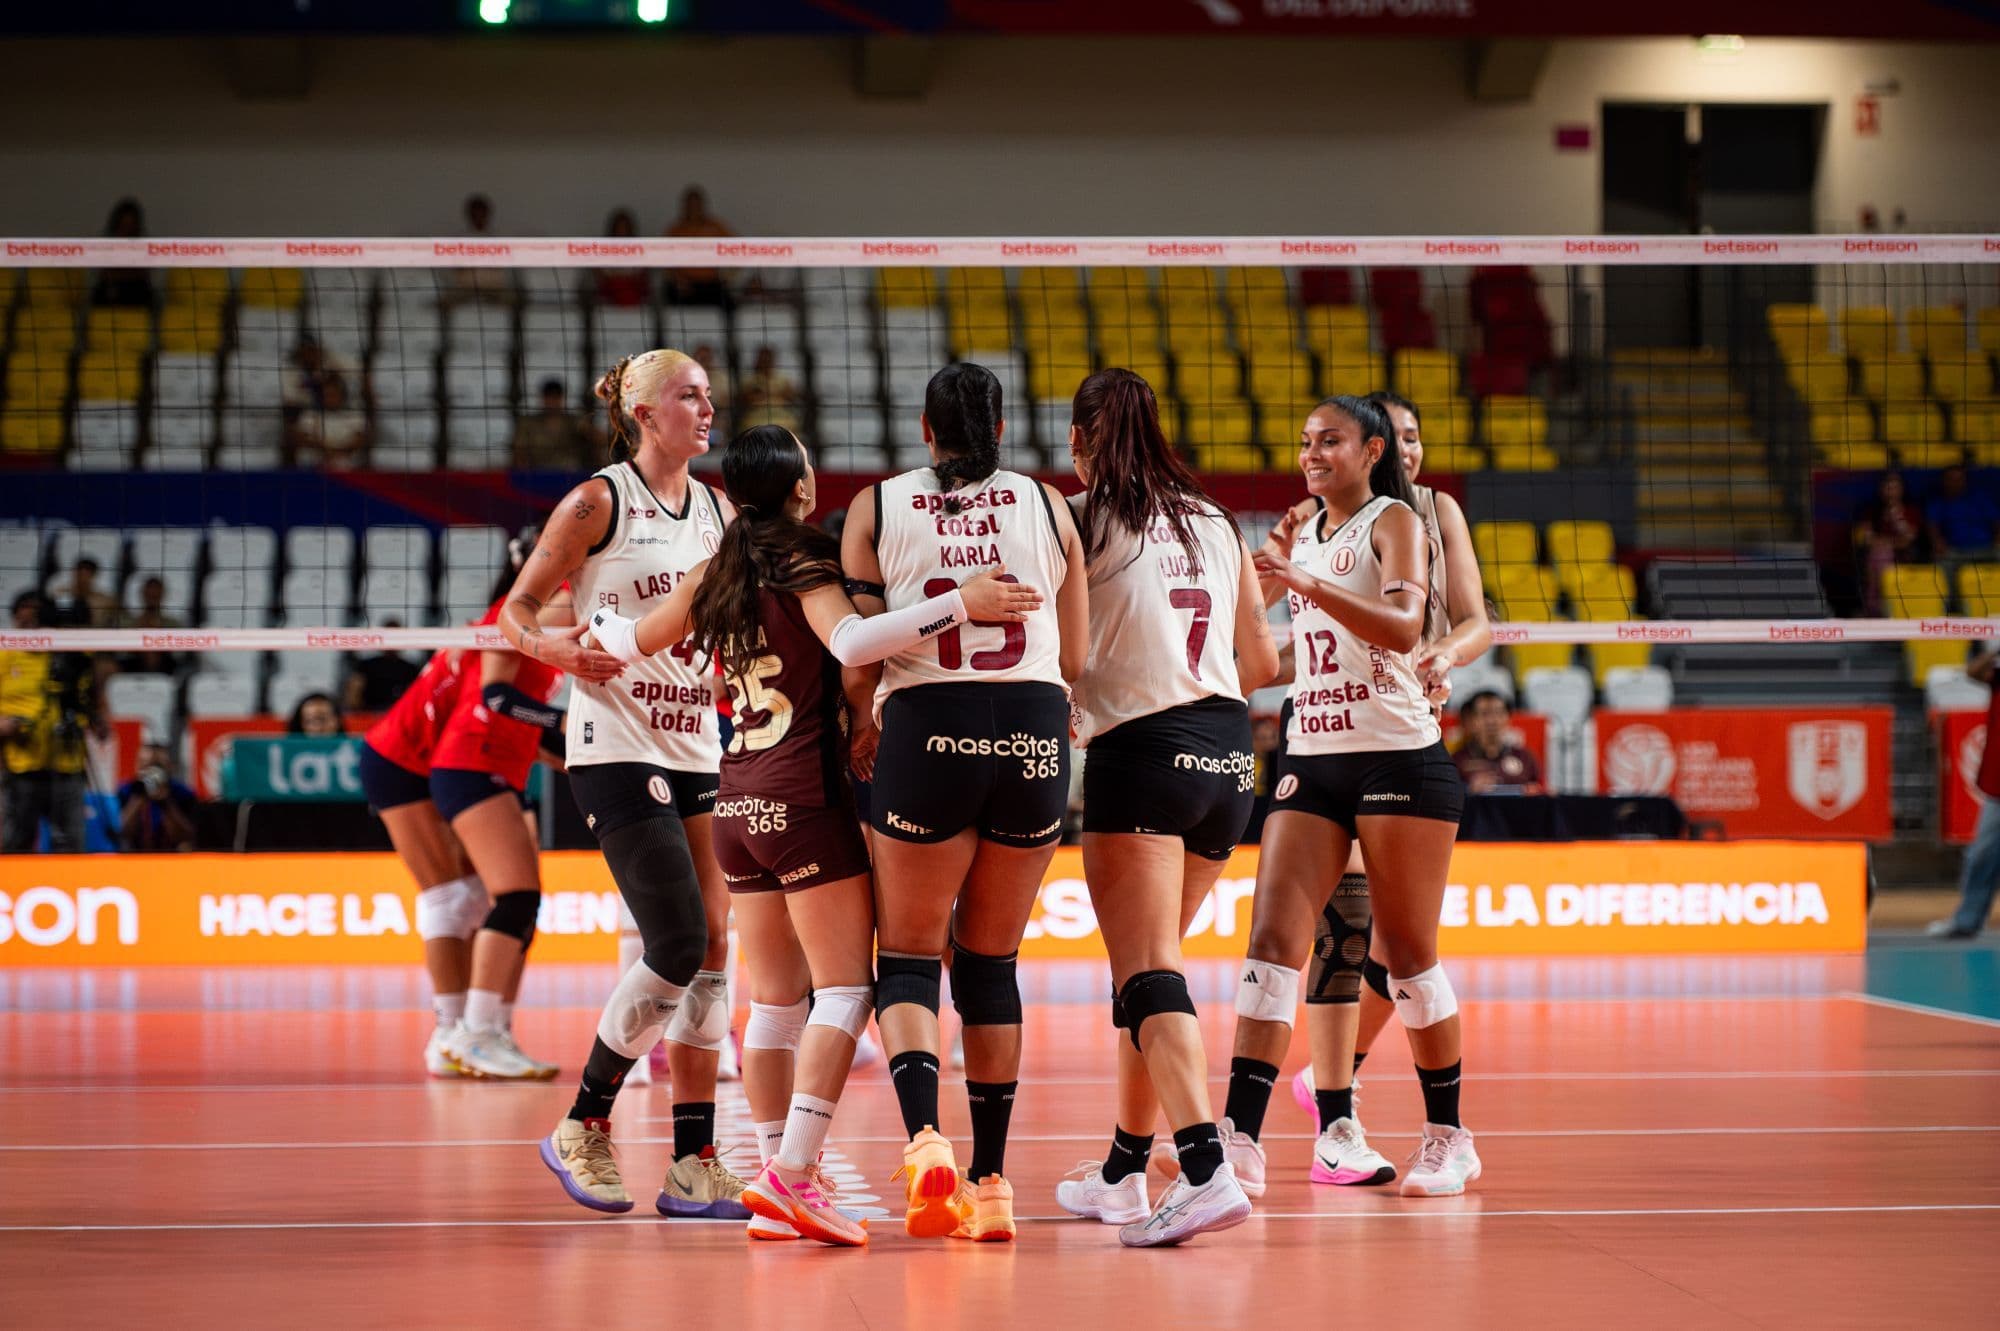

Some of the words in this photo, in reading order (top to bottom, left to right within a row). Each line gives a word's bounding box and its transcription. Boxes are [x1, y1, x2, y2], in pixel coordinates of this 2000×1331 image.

[6, 242, 84, 257] betsson
[147, 242, 225, 257] betsson
[286, 242, 363, 257] betsson
[433, 242, 511, 257] betsson
[567, 242, 644, 257] betsson
[716, 242, 793, 257] betsson
[862, 242, 938, 257] betsson
[1001, 242, 1077, 257] betsson
[1147, 242, 1223, 257] betsson
[1281, 241, 1357, 256] betsson
[1425, 240, 1500, 254] betsson
[1565, 240, 1640, 254] betsson
[1703, 240, 1778, 254] betsson
[1843, 240, 1918, 254] betsson
[912, 487, 1017, 515] apesta
[935, 514, 1001, 537] total
[629, 537, 669, 545] marathon
[940, 544, 1002, 569] KARLA
[633, 572, 672, 600] LAS
[918, 614, 956, 638] MNBK
[1169, 588, 1212, 682] 7
[1617, 625, 1692, 640] betsson
[1769, 624, 1844, 640] betsson
[1921, 620, 1995, 636] betsson
[142, 633, 220, 649] betsson
[306, 633, 385, 648] betsson
[1305, 630, 1339, 676] 12
[631, 680, 712, 707] apuesta
[651, 707, 701, 734] total
[1301, 709, 1355, 734] total
[926, 732, 1060, 757] mascotas
[1022, 757, 1060, 780] 365
[1363, 792, 1411, 802] marathon
[747, 813, 788, 835] 365
[199, 893, 337, 937] HACE
[343, 893, 409, 936] LA
[1475, 884, 1541, 926] LA
[1546, 881, 1829, 926] DIFERENCIA
